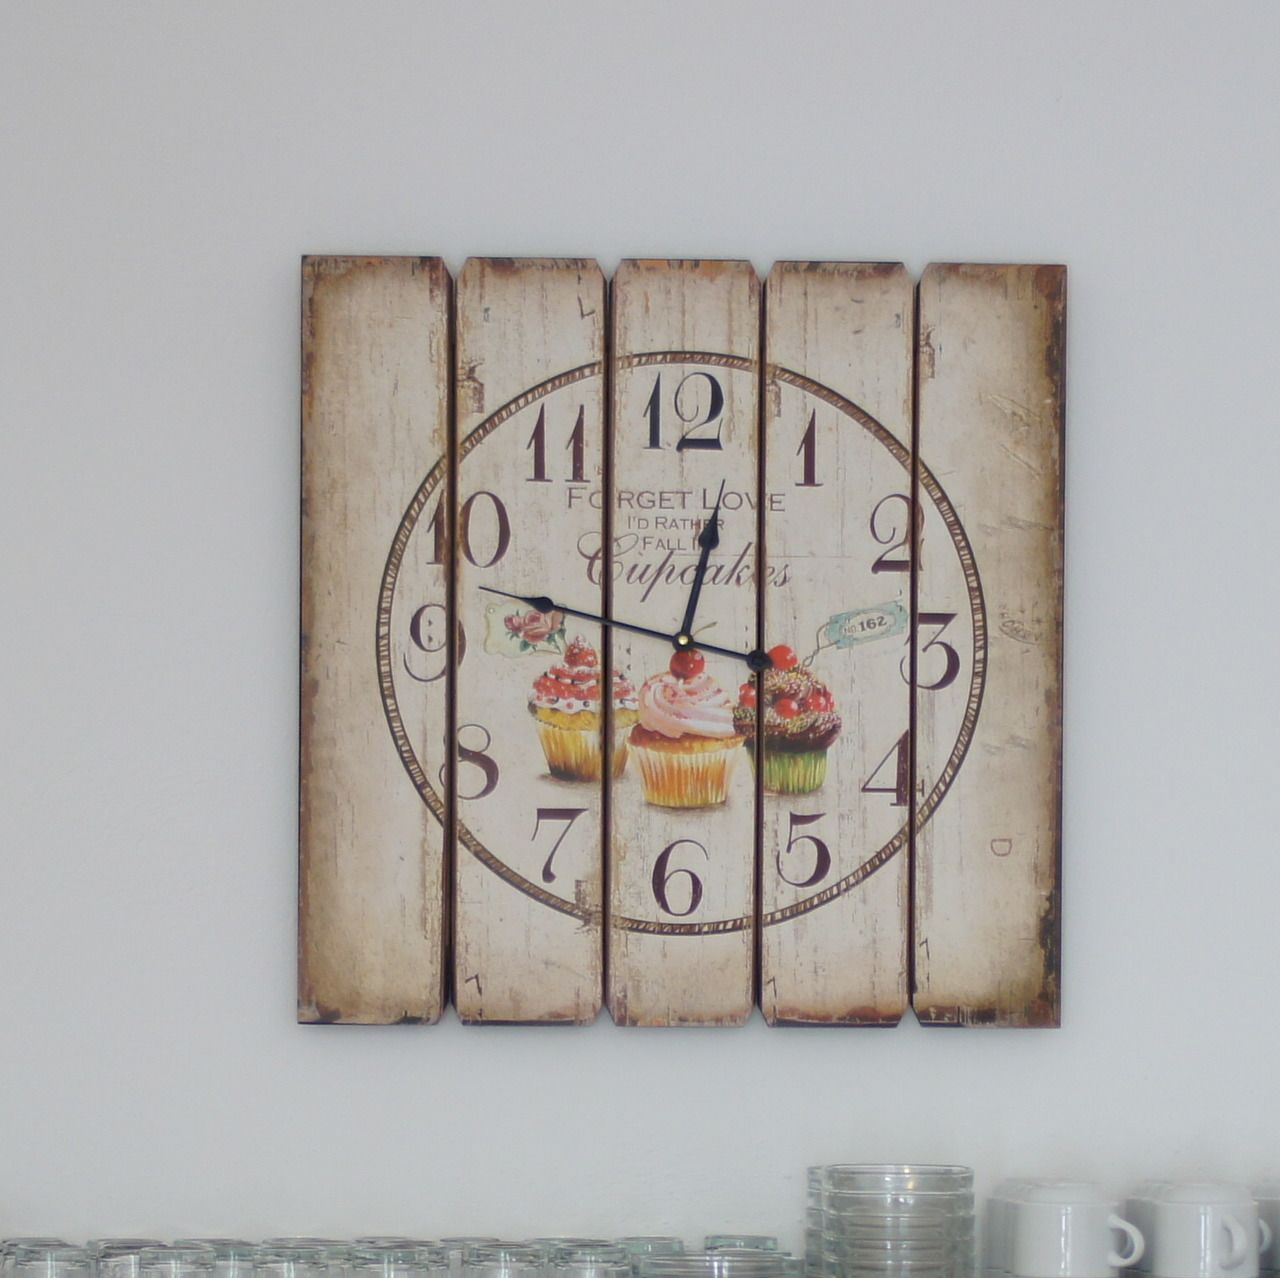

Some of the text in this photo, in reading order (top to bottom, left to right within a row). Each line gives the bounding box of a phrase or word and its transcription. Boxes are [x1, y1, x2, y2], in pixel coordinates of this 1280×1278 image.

[526, 402, 591, 483] 11
[642, 371, 724, 453] 12
[794, 407, 823, 487] 1
[425, 489, 511, 569] 10
[567, 486, 693, 510] FORGET
[627, 515, 649, 531] I'D
[869, 493, 925, 575] 2
[576, 531, 792, 603] Cupcakes
[642, 536, 687, 551] FALL
[403, 603, 466, 682] 9
[858, 615, 888, 633] 162
[900, 611, 961, 690] 3
[439, 723, 499, 800] 8
[861, 728, 925, 807] 4
[531, 807, 590, 884] 7
[651, 838, 710, 917] 6
[775, 810, 832, 888] 5
